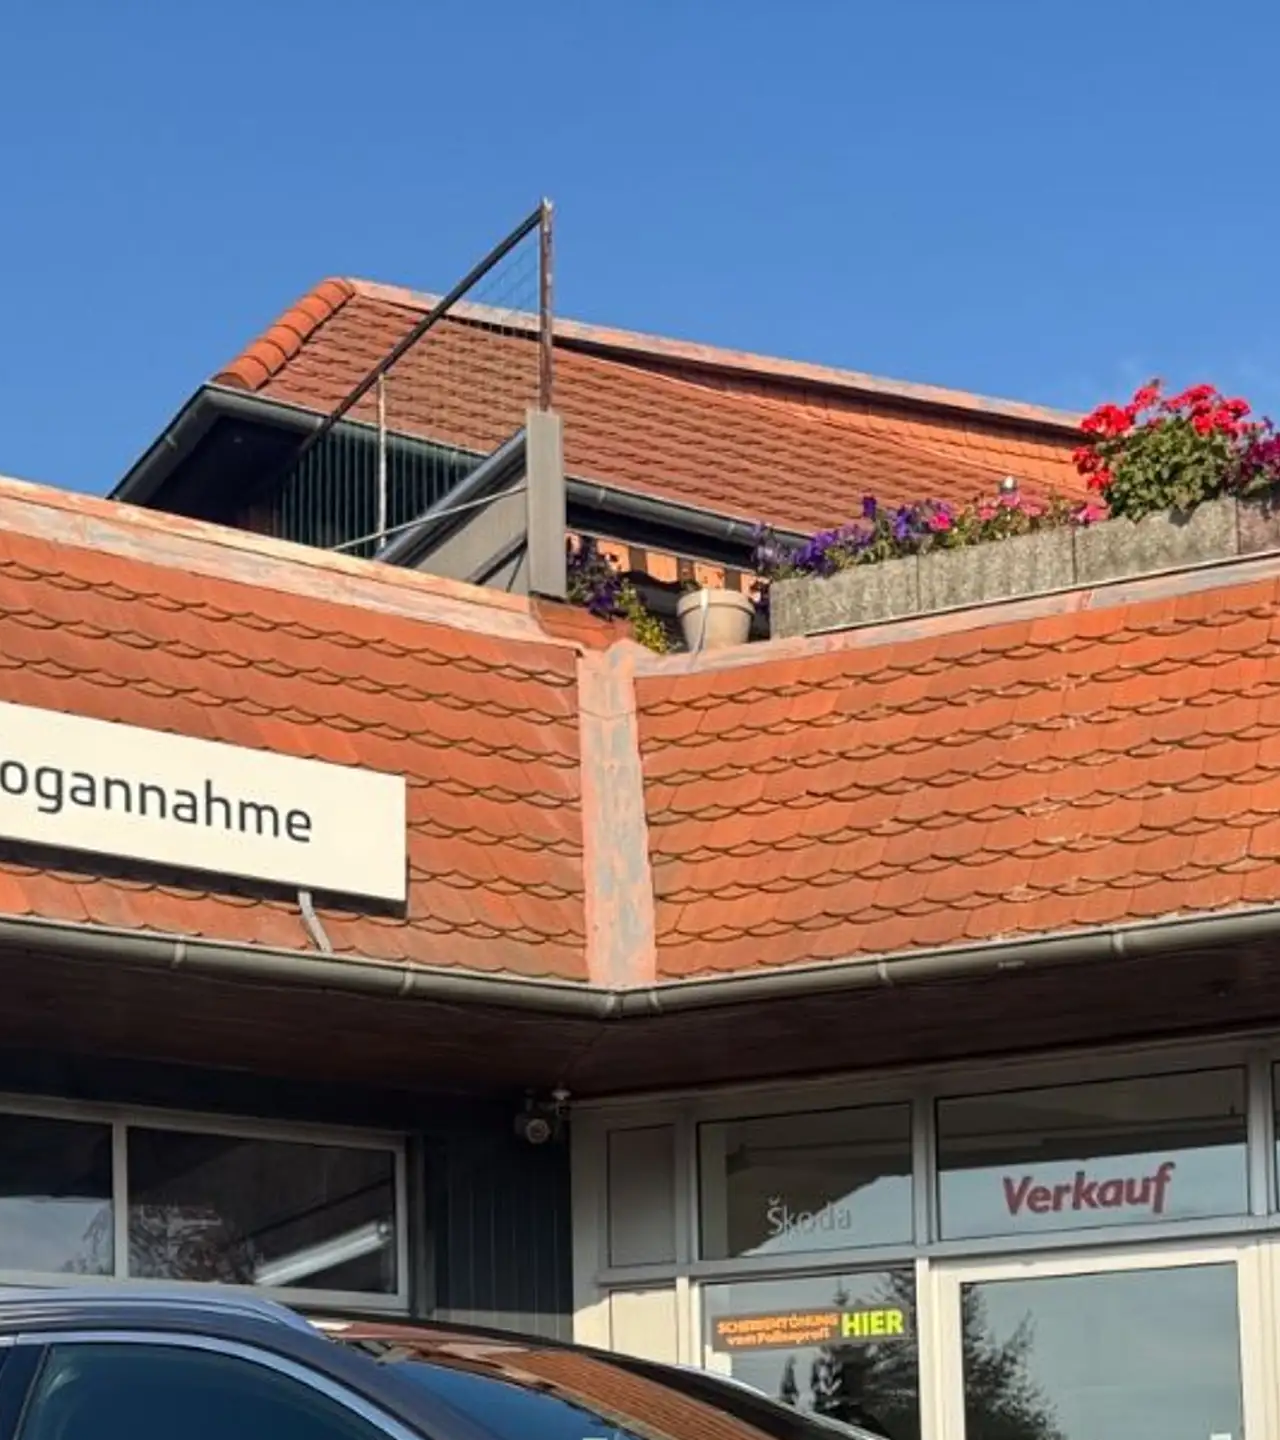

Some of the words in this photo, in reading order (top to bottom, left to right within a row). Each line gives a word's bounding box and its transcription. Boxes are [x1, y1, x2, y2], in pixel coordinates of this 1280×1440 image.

[1002, 1161, 1176, 1216] Verkauf
[766, 1195, 851, 1235] Škoda
[841, 1309, 905, 1338] HIER
